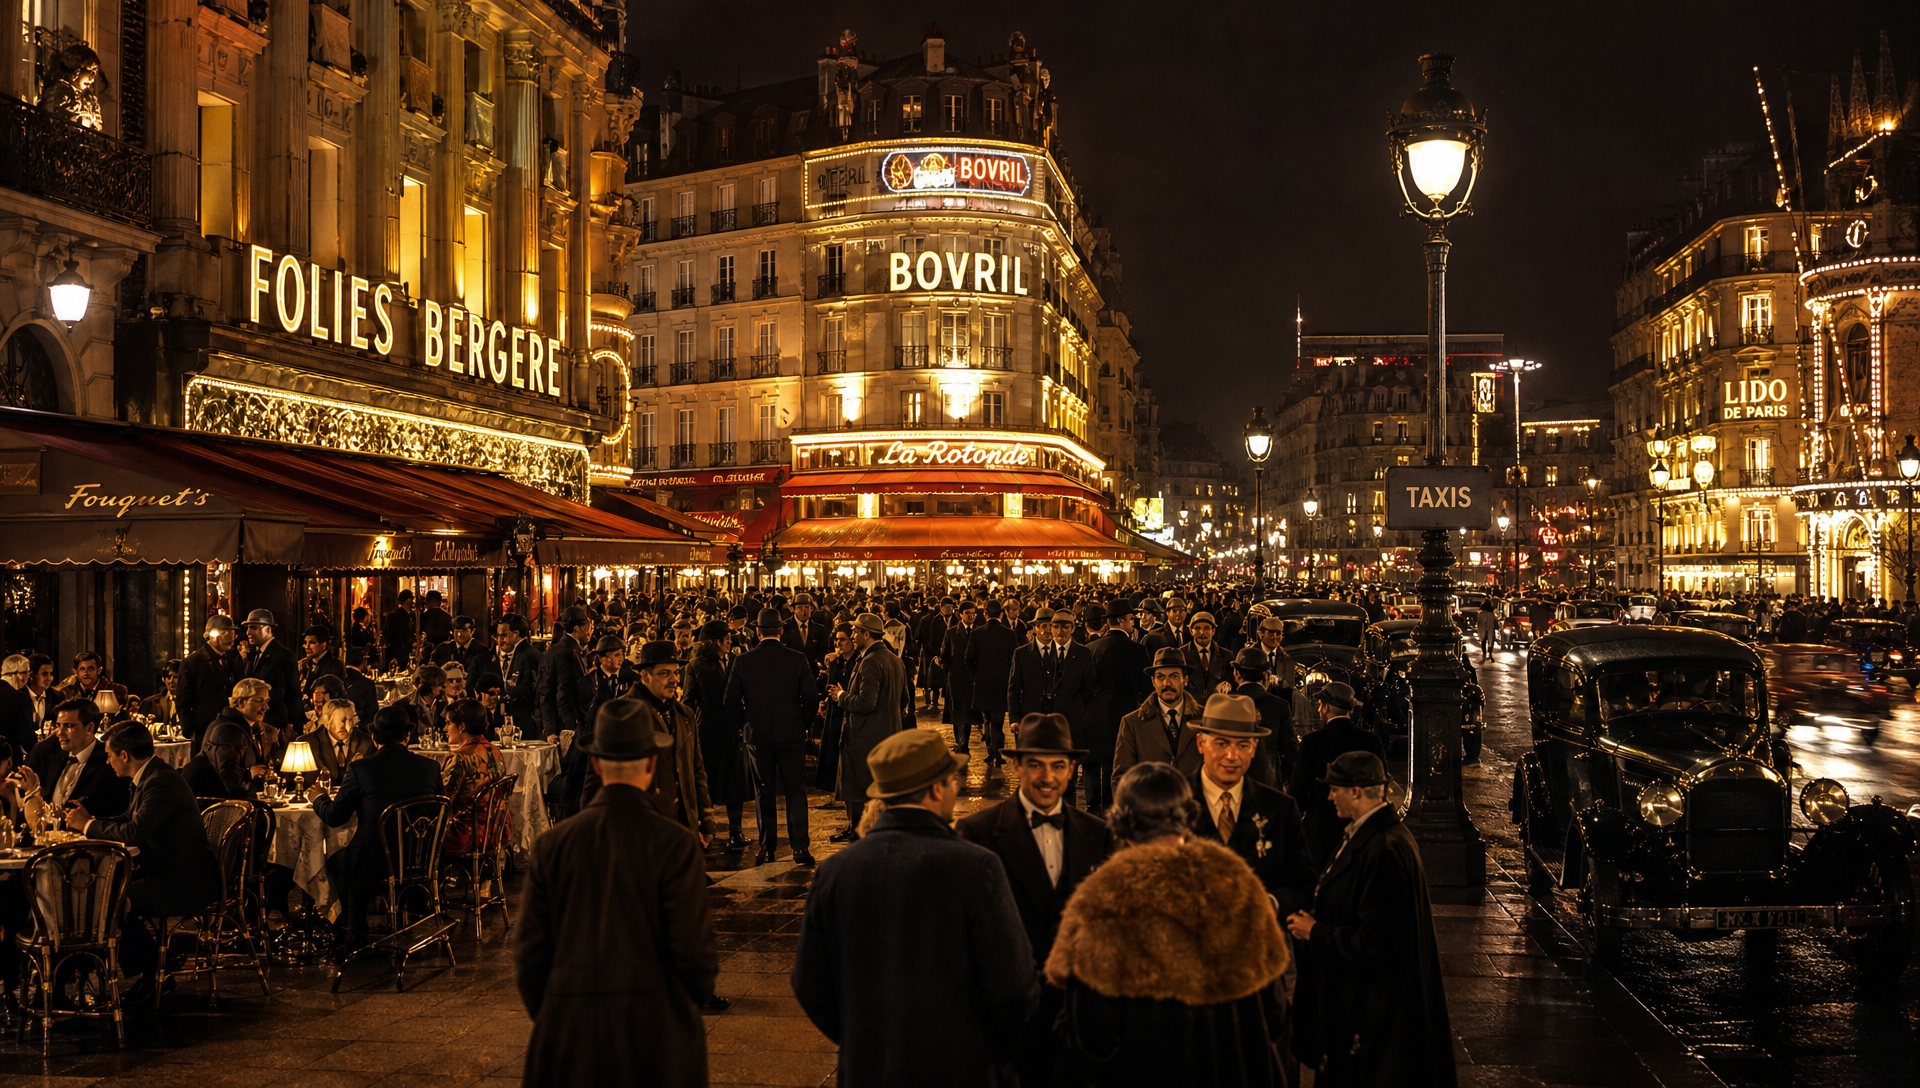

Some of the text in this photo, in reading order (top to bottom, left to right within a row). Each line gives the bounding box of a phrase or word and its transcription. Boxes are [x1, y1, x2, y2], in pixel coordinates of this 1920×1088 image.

[961, 157, 1026, 184] BOVRIL
[889, 250, 1029, 296] BOVRIL
[250, 244, 561, 397] FOLIES BERGERE
[1724, 379, 1787, 404] LIDO
[1724, 405, 1788, 420] DE PARIS
[877, 441, 1030, 465] La Rotonde
[65, 483, 212, 518] Fouquet's
[1406, 486, 1472, 508] TAXIS
